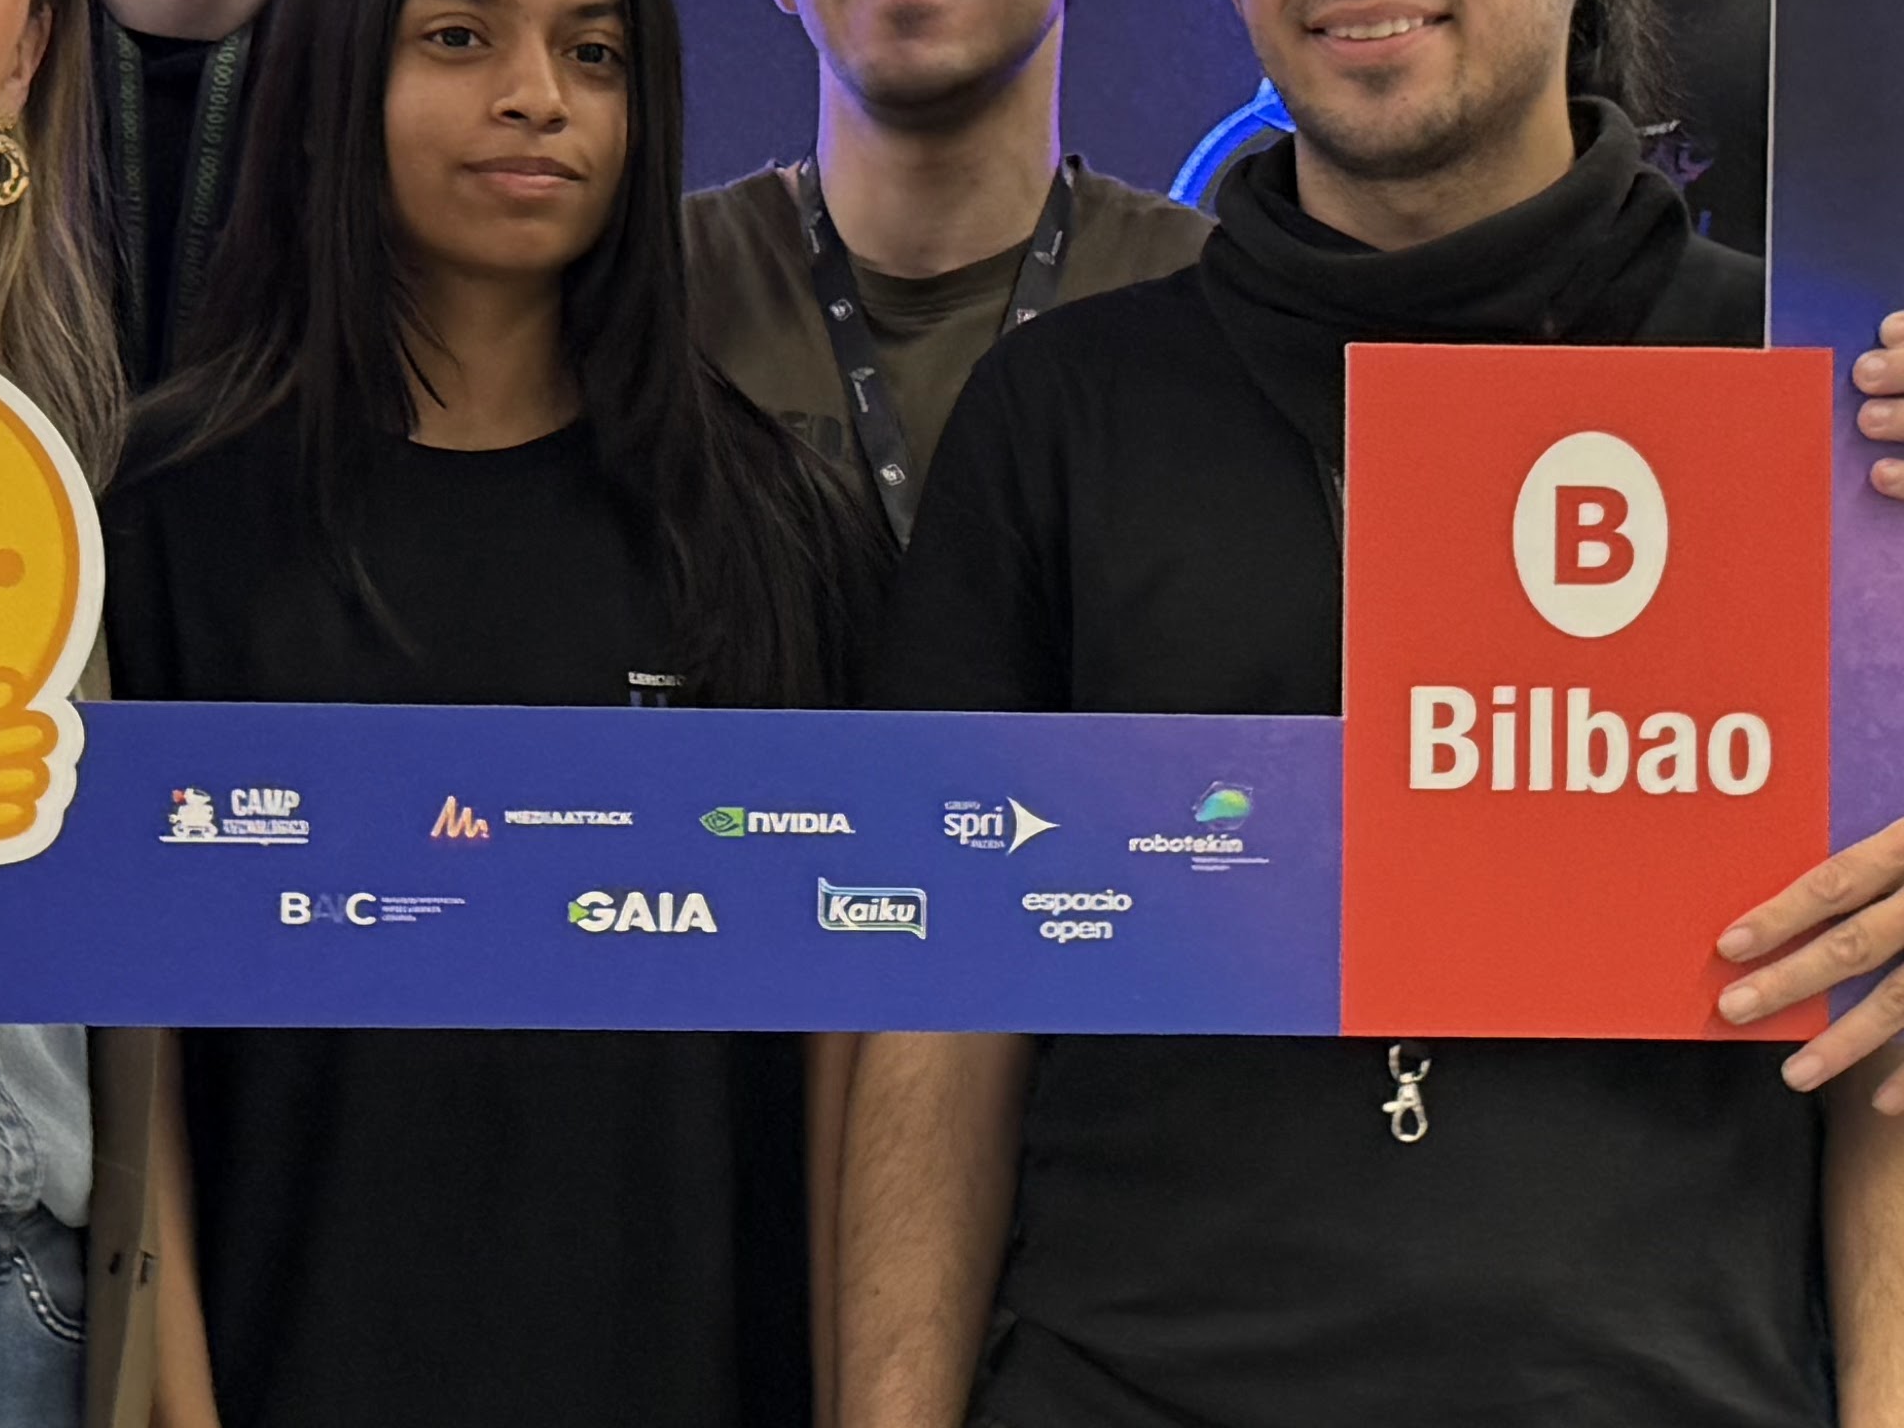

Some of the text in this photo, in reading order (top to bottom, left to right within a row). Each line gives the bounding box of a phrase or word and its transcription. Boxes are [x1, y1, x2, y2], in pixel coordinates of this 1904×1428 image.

[1554, 485, 1636, 586] B
[1410, 685, 1772, 796] Bilbao
[231, 788, 301, 817] CAMP
[943, 806, 1004, 845] spri
[575, 891, 718, 933] GAIA
[828, 895, 916, 928] Kaiku
[1022, 890, 1132, 914] espacio
[1039, 919, 1113, 943] open
